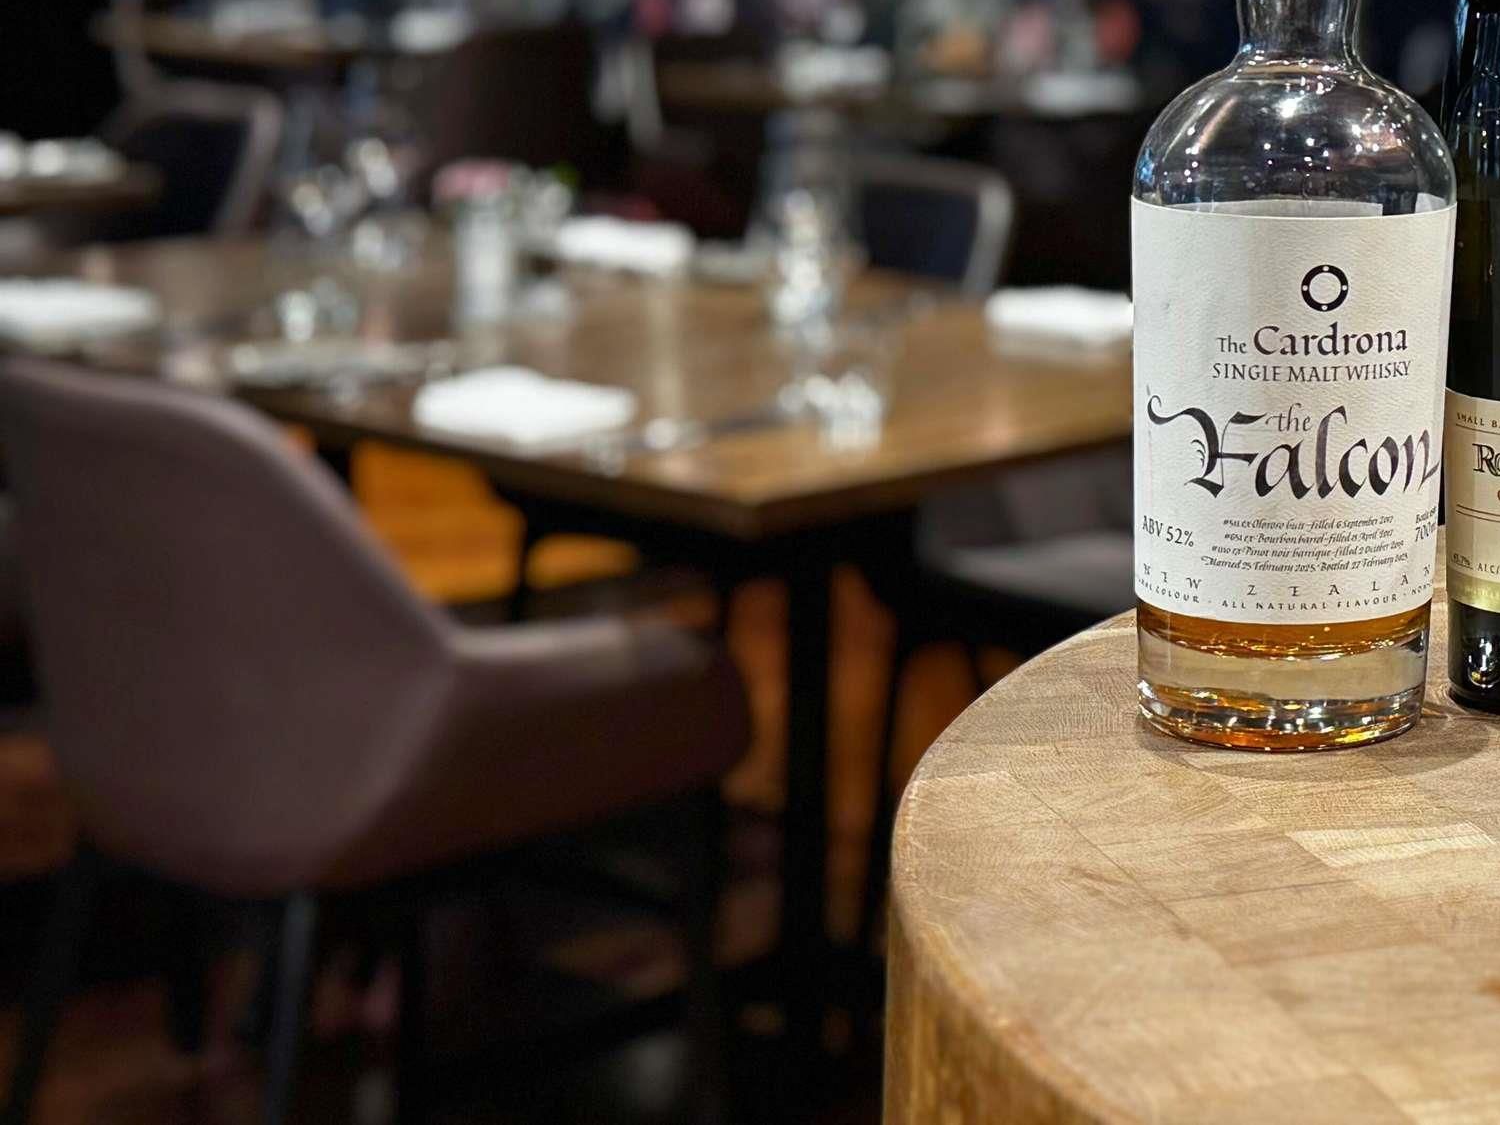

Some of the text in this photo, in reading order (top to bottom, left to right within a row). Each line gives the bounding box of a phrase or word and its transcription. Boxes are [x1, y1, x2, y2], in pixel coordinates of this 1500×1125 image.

[1216, 321, 1408, 357] The Cardrona
[1212, 359, 1412, 383] SINGLE MALT WHISKY
[1265, 402, 1311, 433] the
[1147, 393, 1440, 499] Falcon
[1142, 515, 1194, 547] ABV 52%
[1221, 599, 1247, 609] ALL
[1255, 602, 1328, 611] NATURAL
[1336, 593, 1397, 608] FLAVOUR
